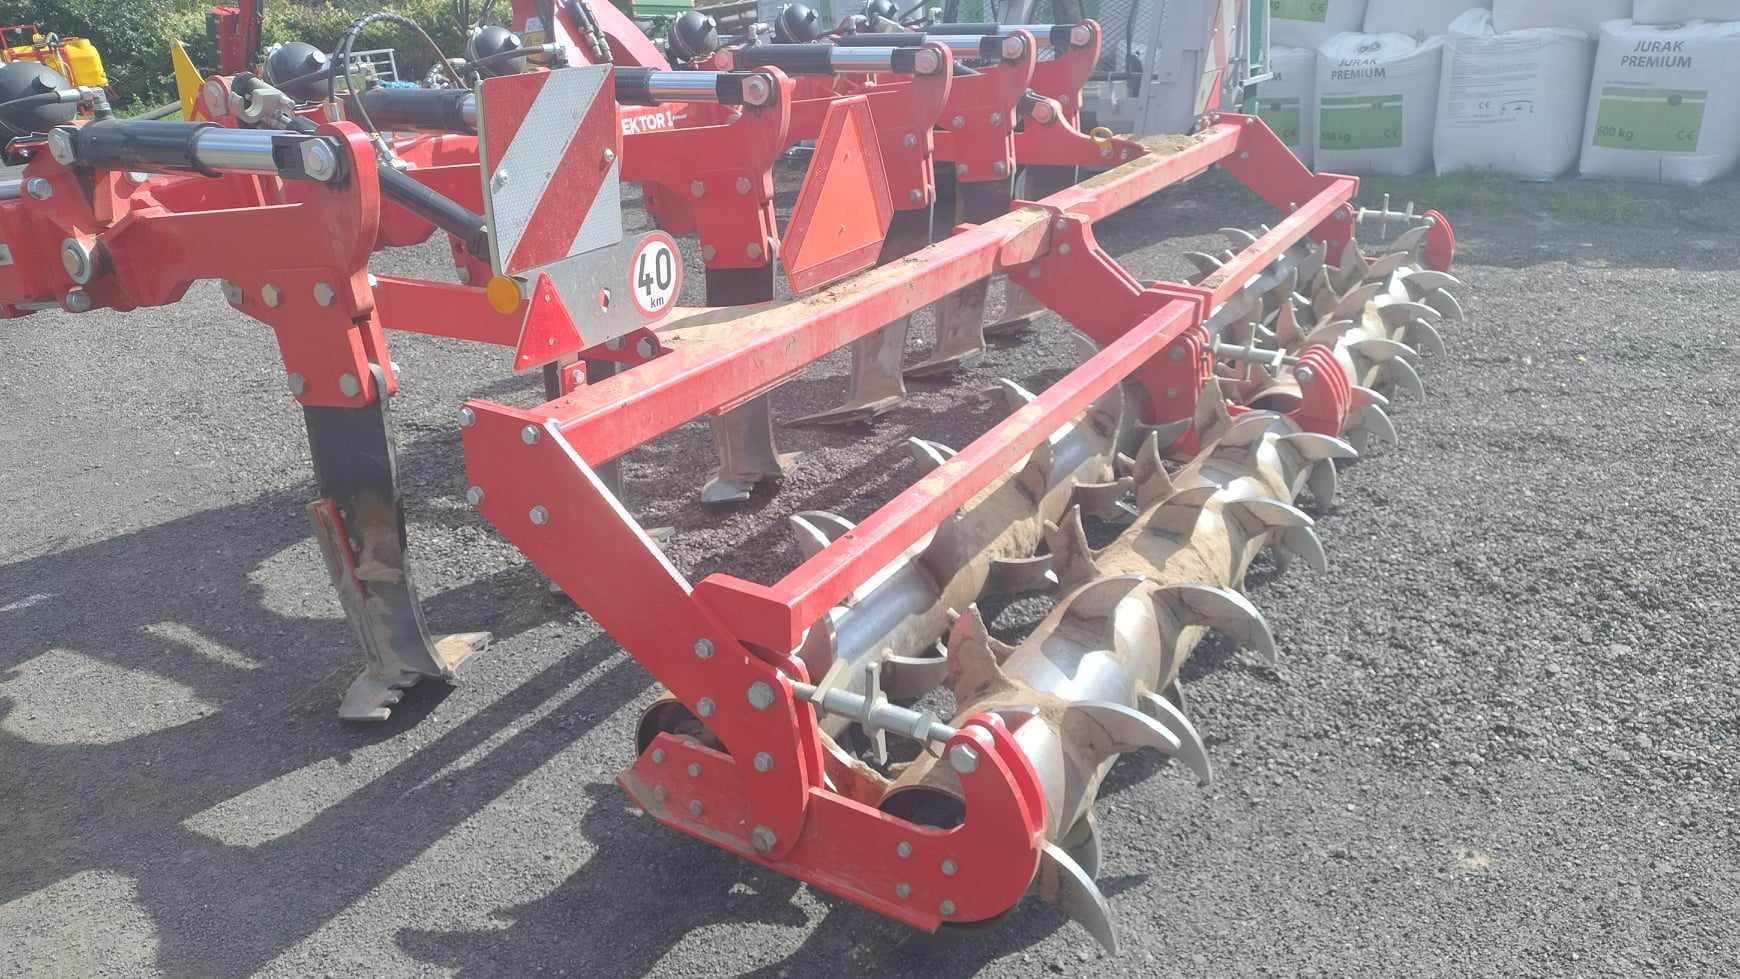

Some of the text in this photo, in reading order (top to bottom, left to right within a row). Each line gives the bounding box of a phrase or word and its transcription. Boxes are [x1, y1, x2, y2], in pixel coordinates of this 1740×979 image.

[1633, 40, 1685, 53] JURAK
[1620, 55, 1692, 68] PREMIUM
[1330, 67, 1386, 81] PREMIUM
[1618, 127, 1634, 142] kg
[638, 248, 672, 297] 40
[650, 296, 665, 309] km
